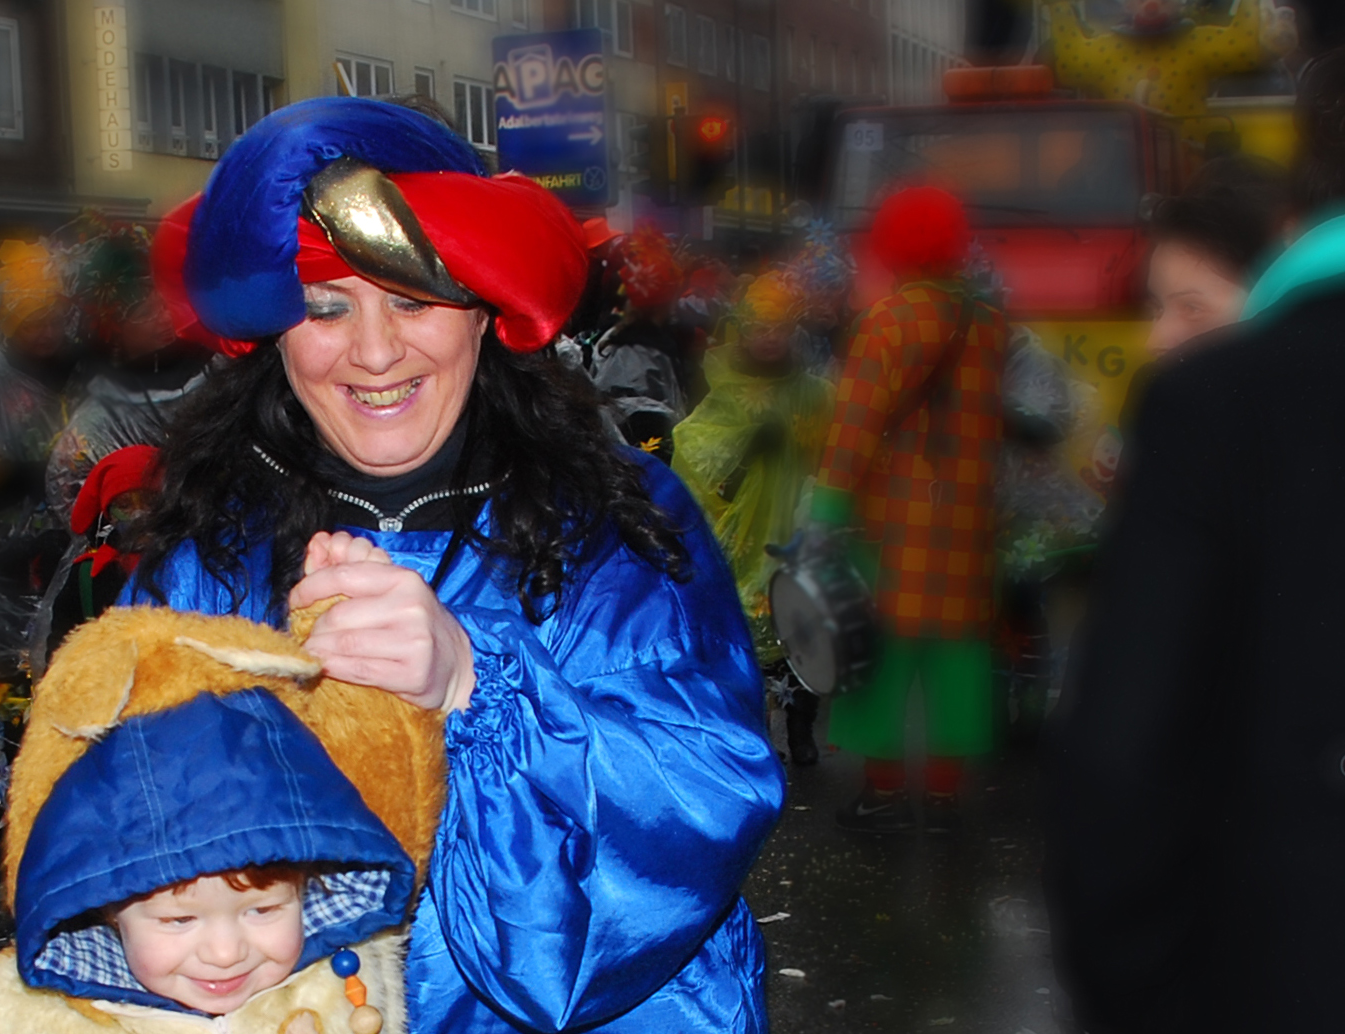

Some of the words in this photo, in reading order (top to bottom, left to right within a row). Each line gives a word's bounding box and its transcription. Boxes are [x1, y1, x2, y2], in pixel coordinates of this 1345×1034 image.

[101, 10, 120, 168] MODEHAUS
[494, 54, 603, 99] APAG
[854, 129, 871, 146] 95
